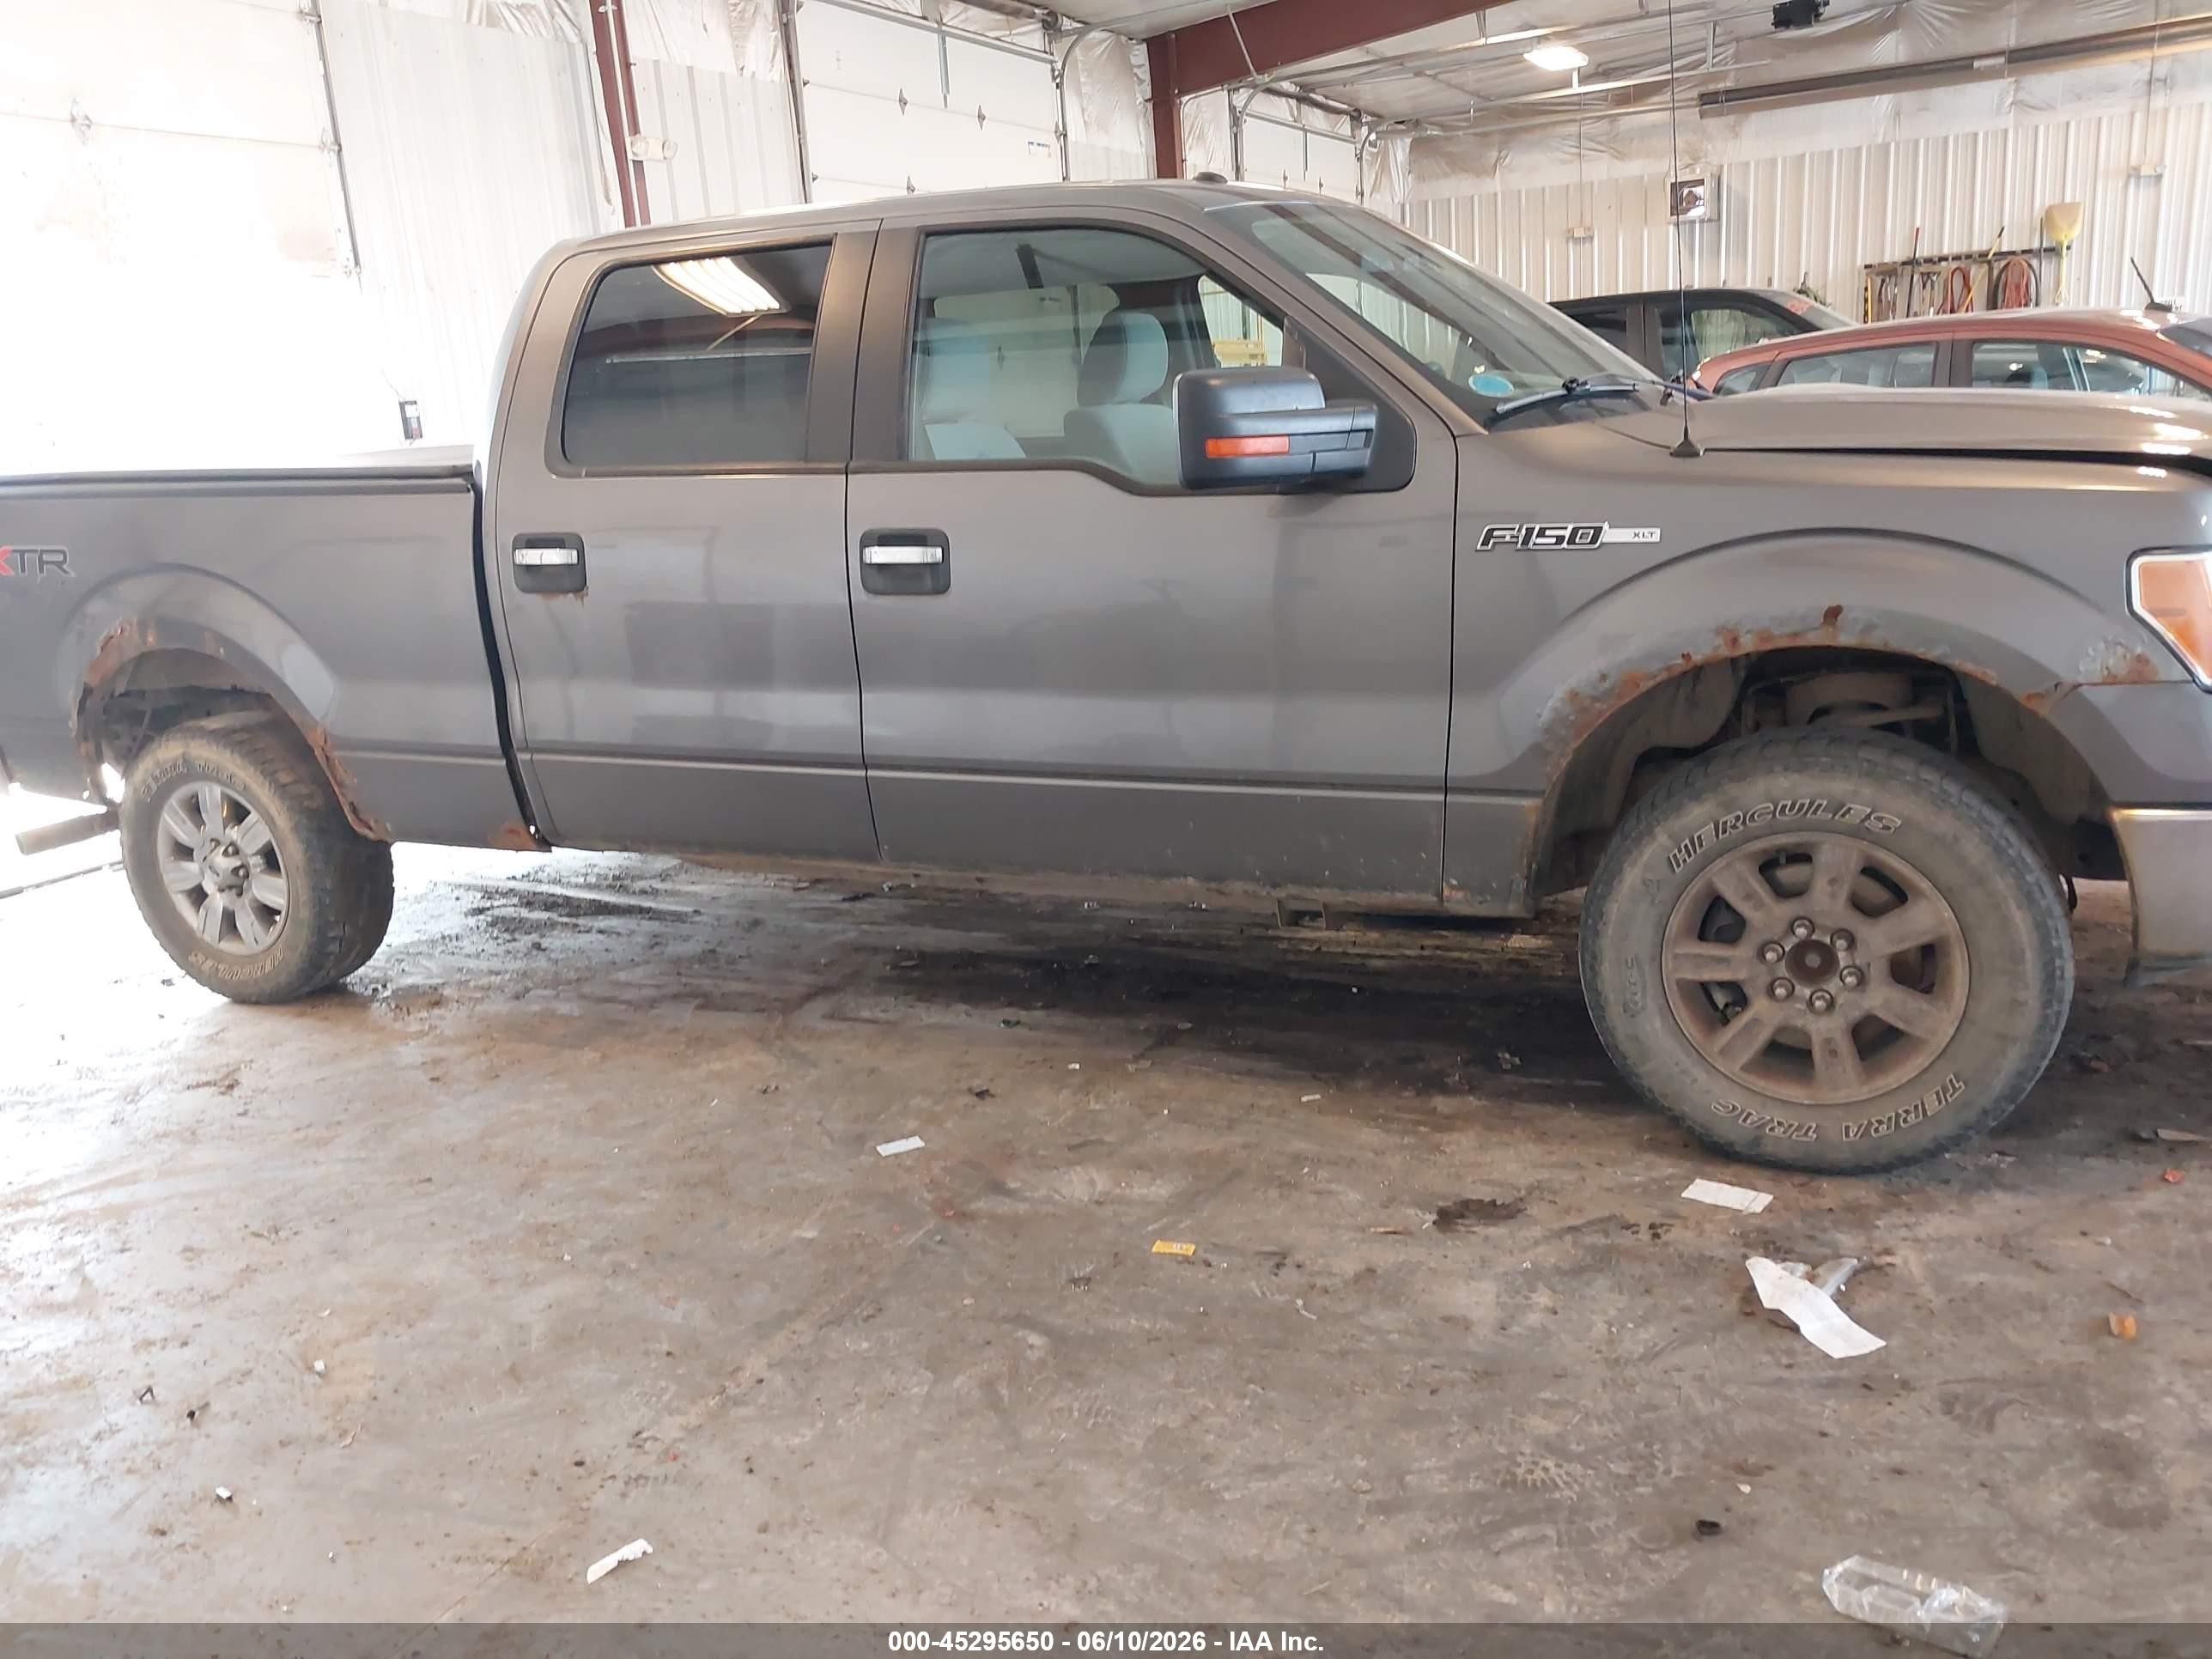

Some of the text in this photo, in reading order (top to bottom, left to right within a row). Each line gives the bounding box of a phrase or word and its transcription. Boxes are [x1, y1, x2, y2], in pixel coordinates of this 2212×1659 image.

[1475, 521, 1657, 551] F-150 XLT
[1668, 799, 1901, 872] HERCULES
[1711, 1073, 1965, 1141] TERRA TRAC
